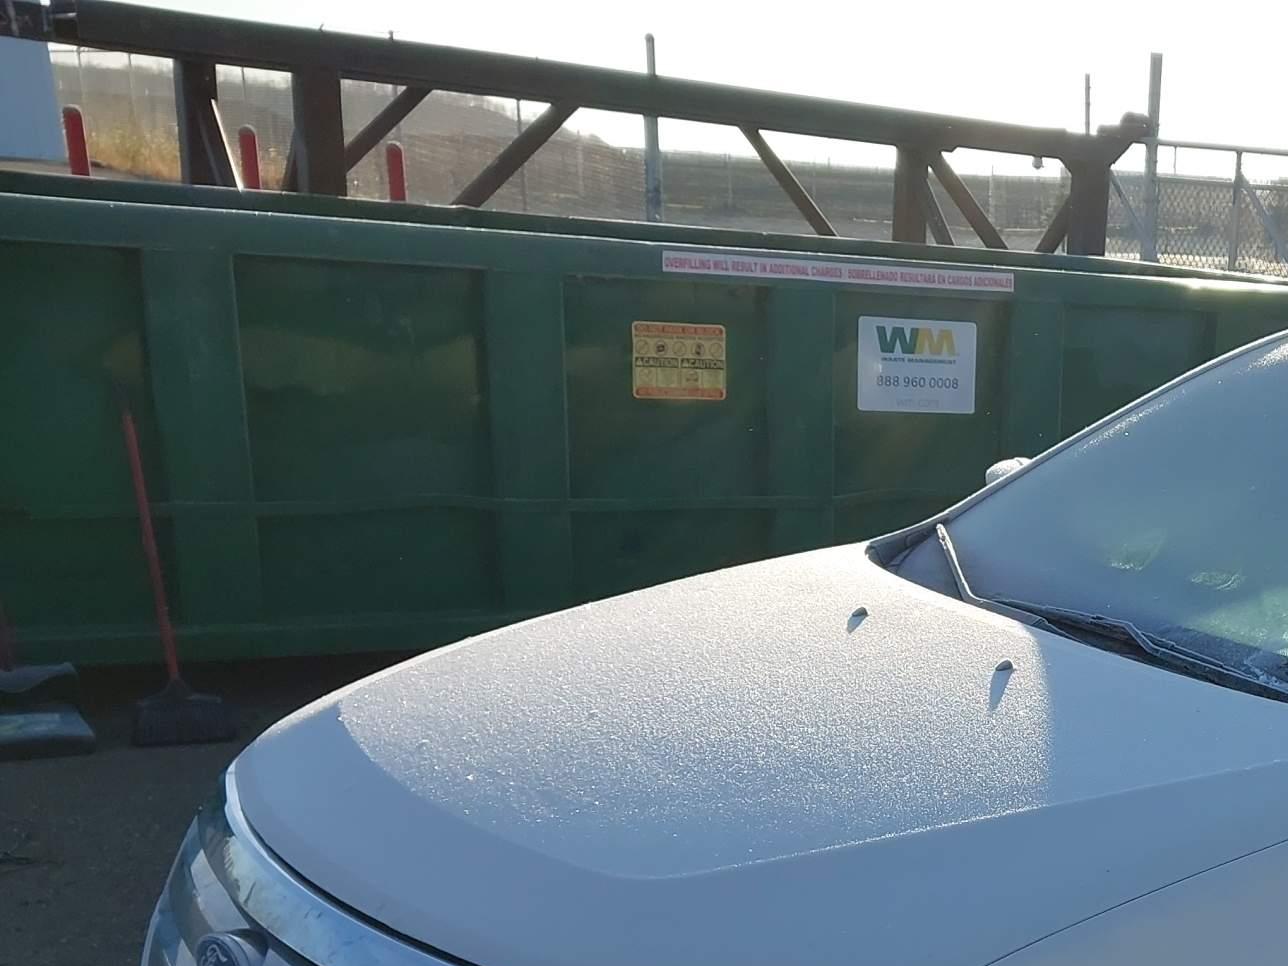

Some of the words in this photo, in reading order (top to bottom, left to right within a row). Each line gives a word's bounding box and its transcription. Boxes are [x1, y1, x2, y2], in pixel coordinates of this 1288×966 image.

[664, 256, 711, 270] OVERFILLING
[712, 258, 730, 272] WILL
[731, 260, 758, 273] RESULT
[759, 262, 768, 274] IN
[769, 262, 809, 277] ADDITIONAL
[811, 265, 842, 279] CHARGES
[947, 274, 972, 287] CARGOS
[876, 325, 956, 357] WM
[643, 357, 678, 367] CAUTION
[690, 358, 724, 369] CAUTION
[877, 375, 900, 388] 888
[903, 376, 926, 388] 960
[929, 377, 959, 390] 0008
